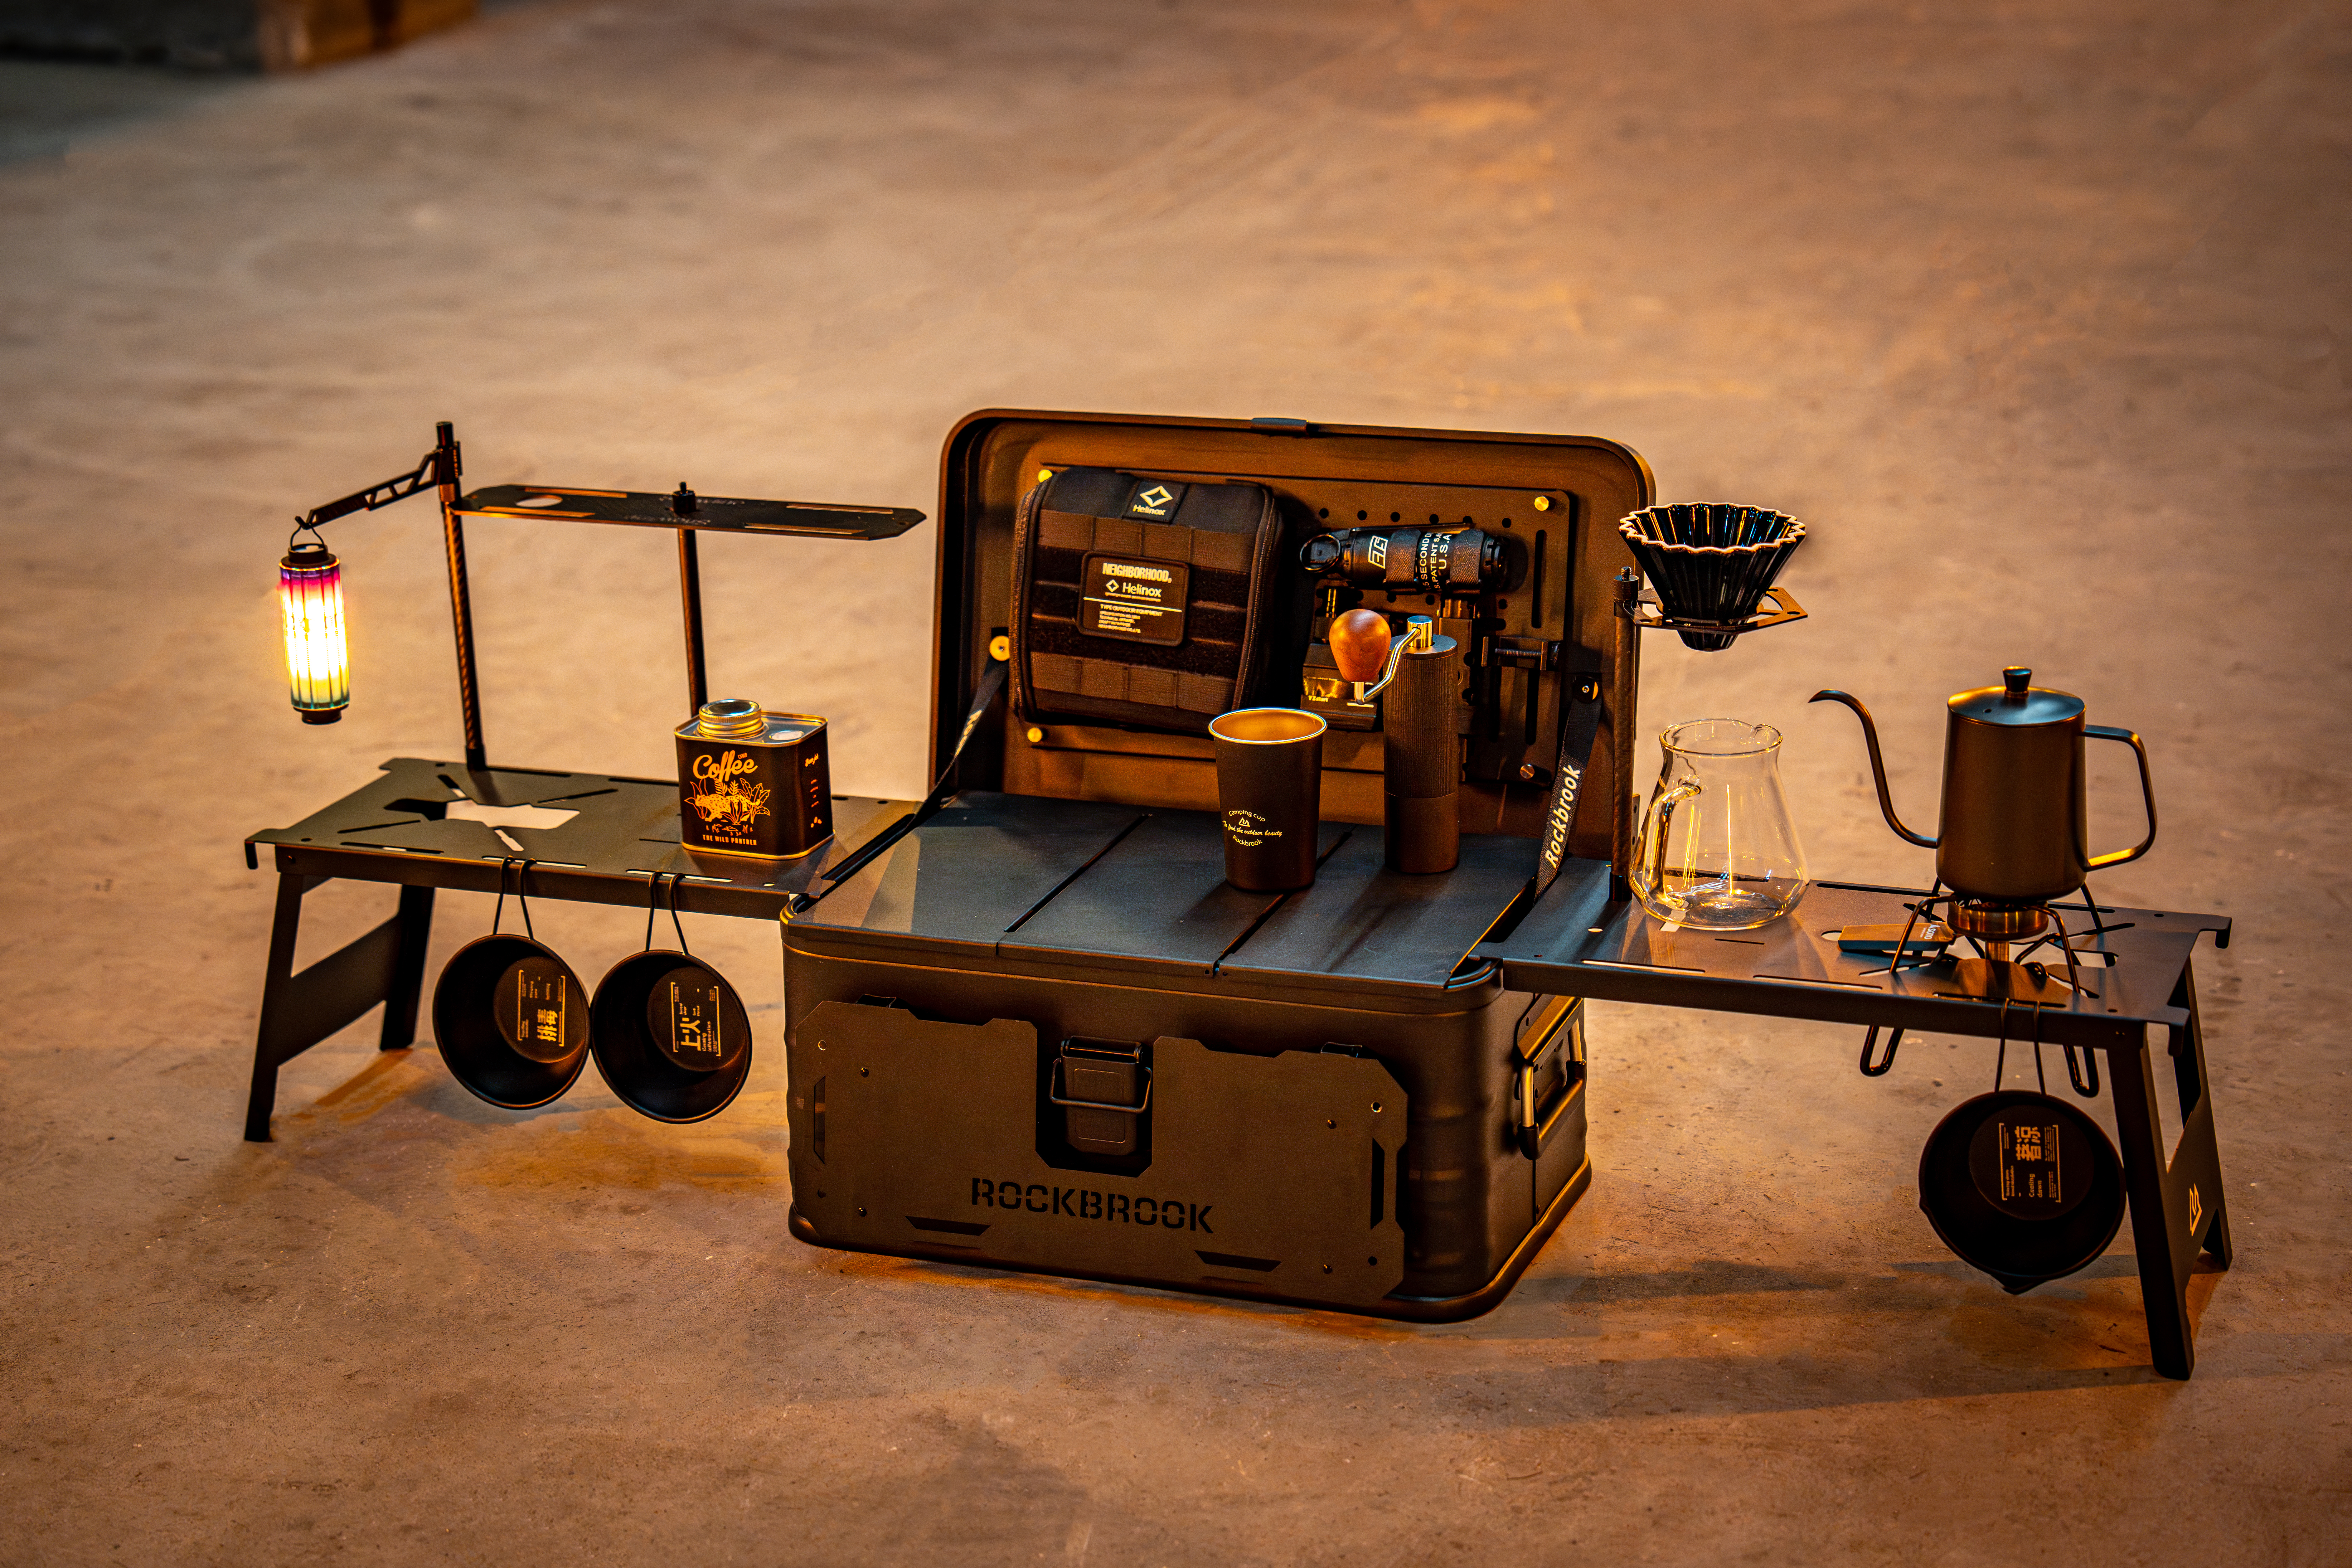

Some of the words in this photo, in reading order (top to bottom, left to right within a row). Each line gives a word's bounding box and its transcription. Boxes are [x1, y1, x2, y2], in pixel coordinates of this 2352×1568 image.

[1133, 504, 1166, 515] Helinox
[1420, 538, 1430, 579] SECOND
[1122, 582, 1162, 597] Helinox
[693, 750, 758, 782] Coffee
[1545, 764, 1580, 869] Rockbrook
[1233, 835, 1263, 846] Rockbrook
[1924, 928, 1936, 939] SOTO
[679, 1017, 701, 1051] 上火
[972, 1178, 1214, 1234] ROCKBROOK
